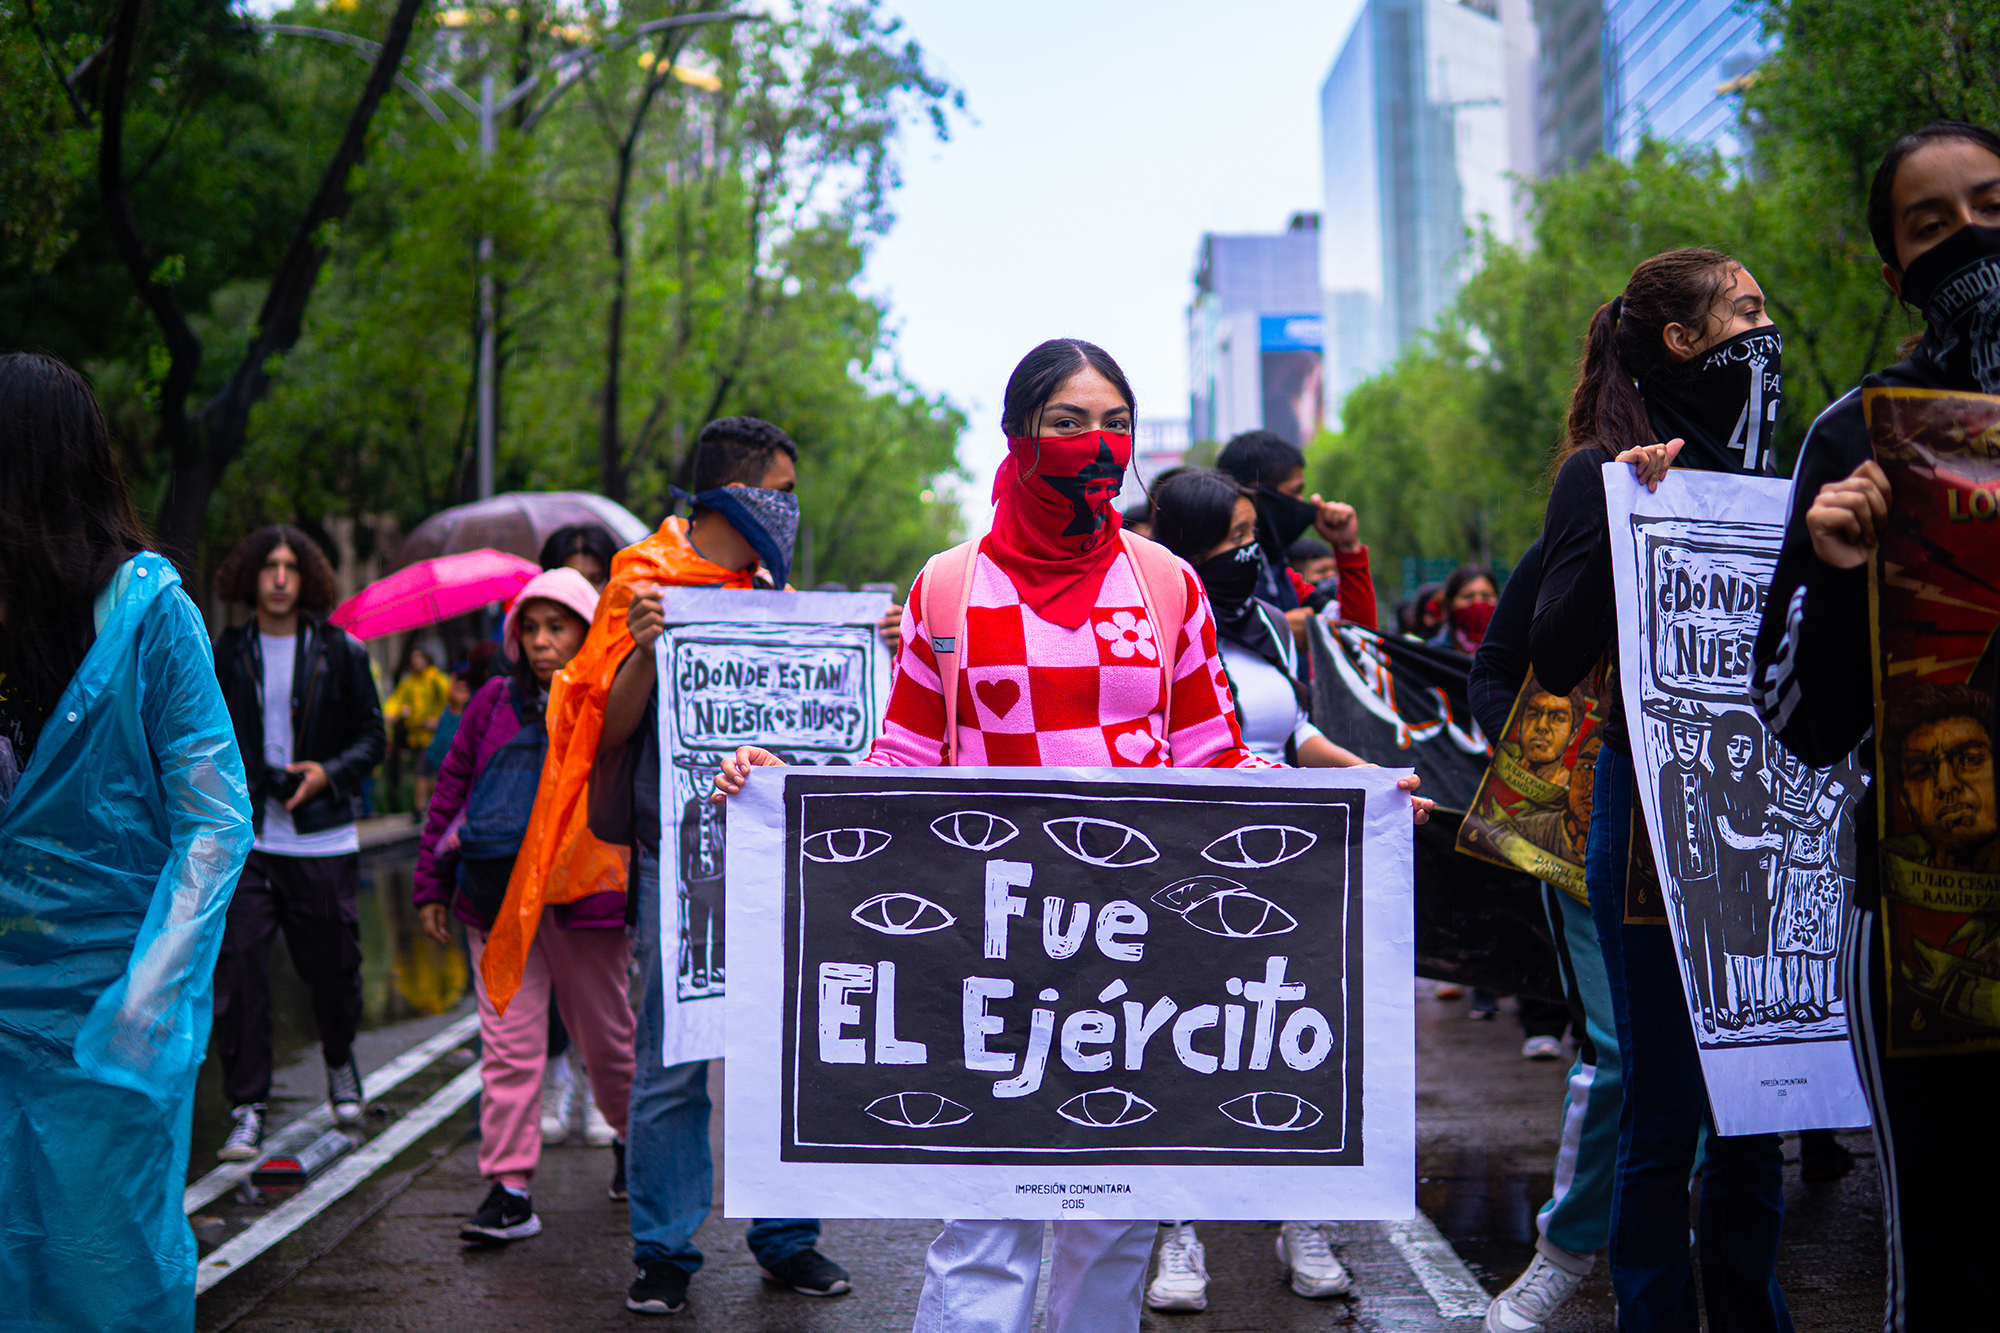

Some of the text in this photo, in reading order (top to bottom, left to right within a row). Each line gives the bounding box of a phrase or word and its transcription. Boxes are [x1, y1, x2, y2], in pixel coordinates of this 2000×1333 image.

[1763, 372, 1782, 393] FA
[1947, 488, 2000, 522] LO
[1675, 622, 1757, 679] NUES
[694, 698, 800, 736] NUESTROS
[1535, 854, 1572, 879] DANIEL
[1908, 870, 1955, 888] JULIO
[984, 859, 1149, 961] Fue
[962, 955, 1335, 1098] Ejército
[1015, 1181, 1132, 1194] IMPRESIÓN COMUNITARIA
[1061, 1199, 1085, 1209] 2015
